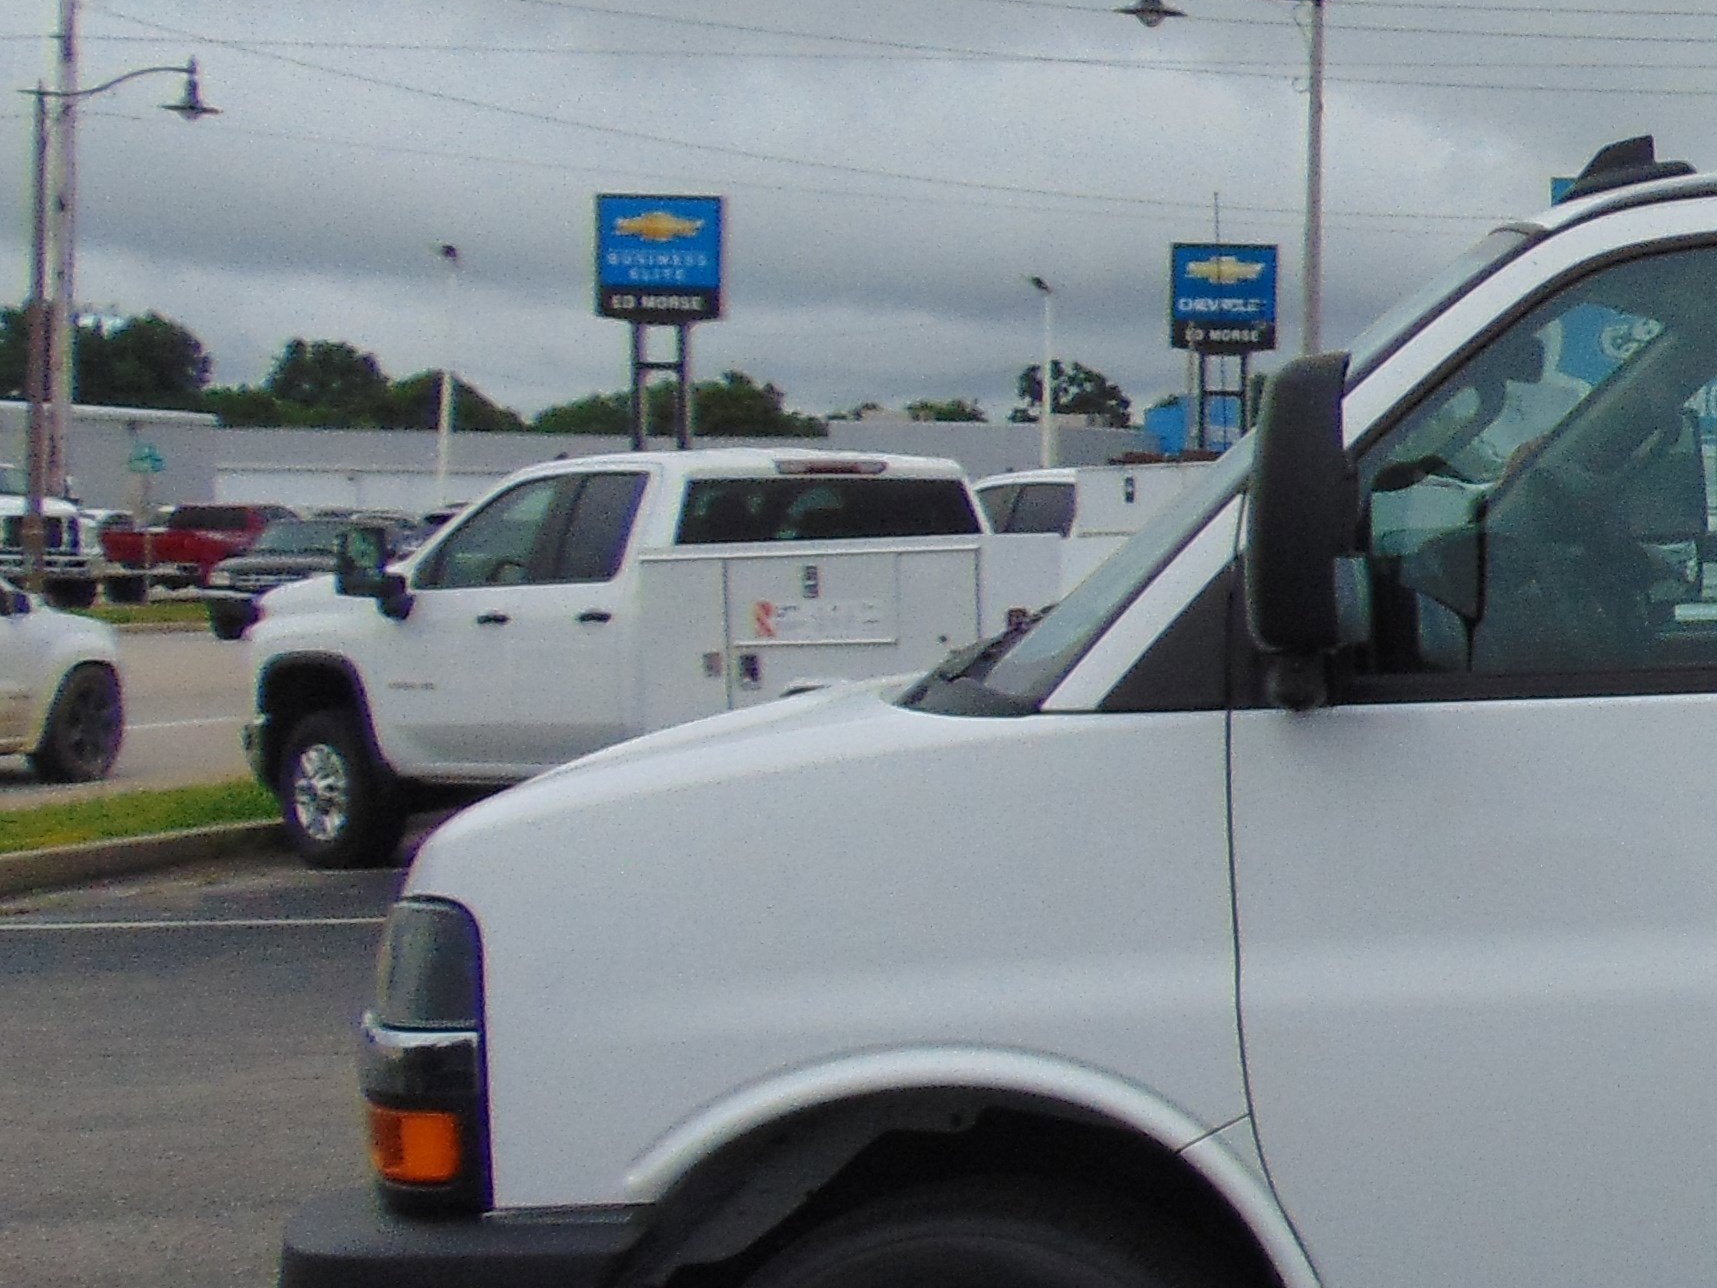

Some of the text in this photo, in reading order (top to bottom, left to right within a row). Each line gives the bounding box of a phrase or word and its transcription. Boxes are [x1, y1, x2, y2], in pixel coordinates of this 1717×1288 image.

[611, 295, 704, 310] ED MORSE
[1209, 329, 1260, 342] MORSE
